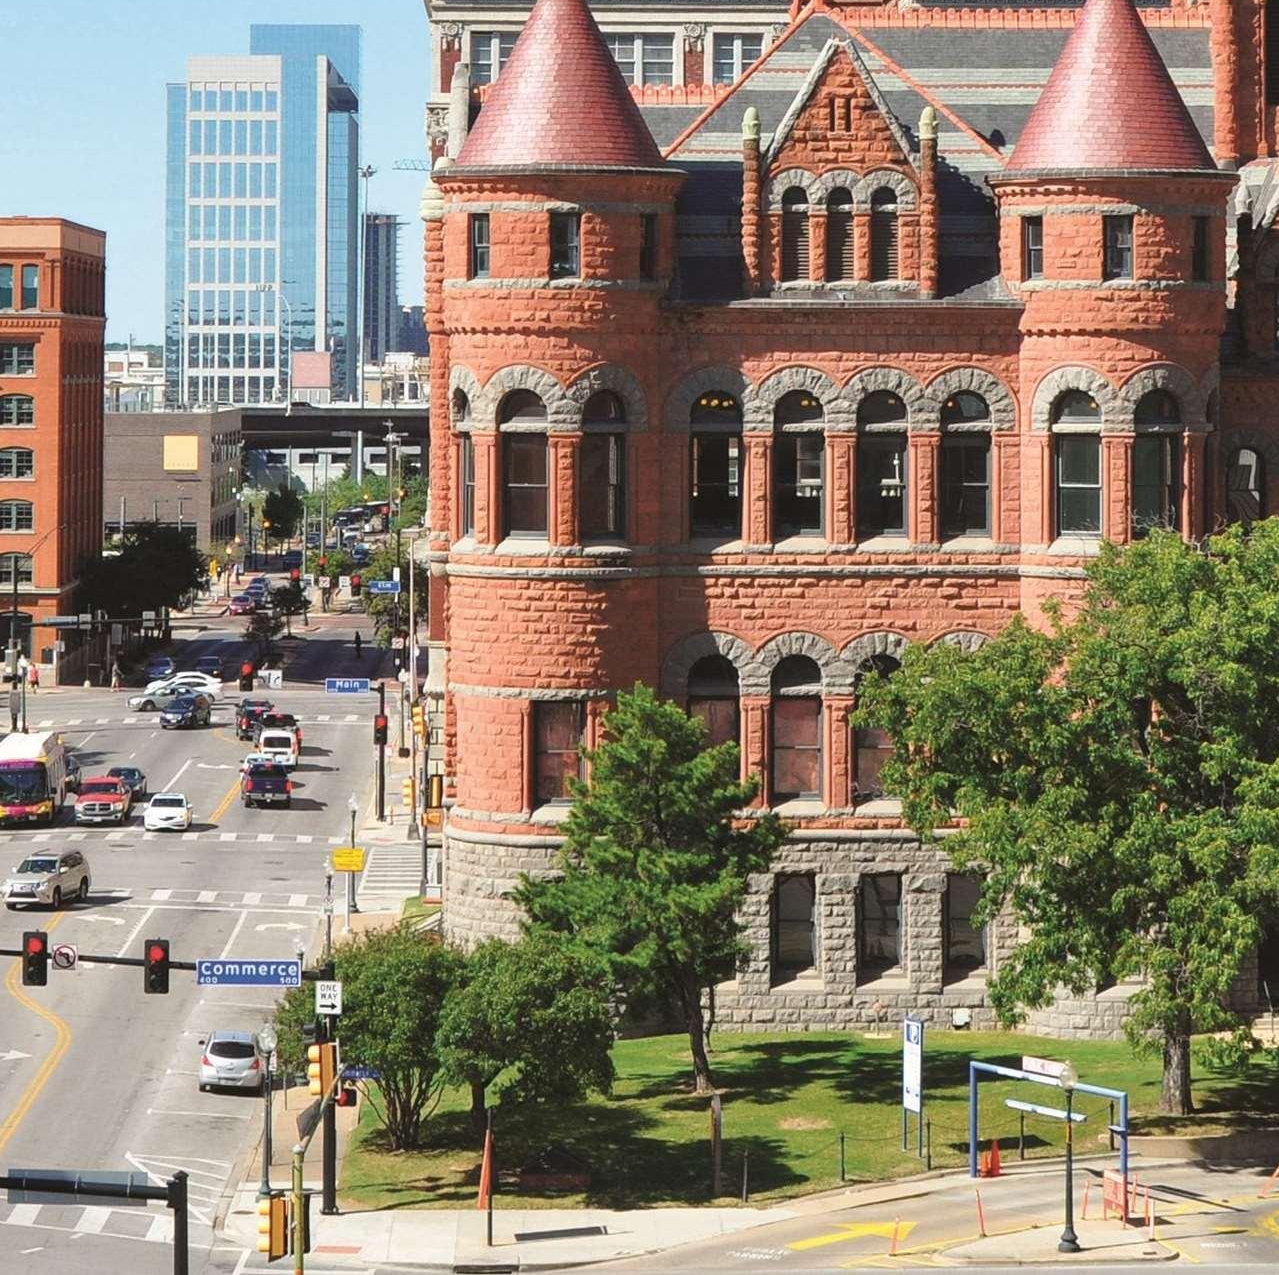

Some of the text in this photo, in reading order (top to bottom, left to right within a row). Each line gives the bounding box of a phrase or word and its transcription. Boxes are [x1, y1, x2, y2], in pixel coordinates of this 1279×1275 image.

[335, 680, 360, 689] Main
[201, 962, 298, 976] Commerce
[200, 976, 218, 984] 400
[320, 983, 337, 993] ONE
[320, 992, 338, 1001] WAY
